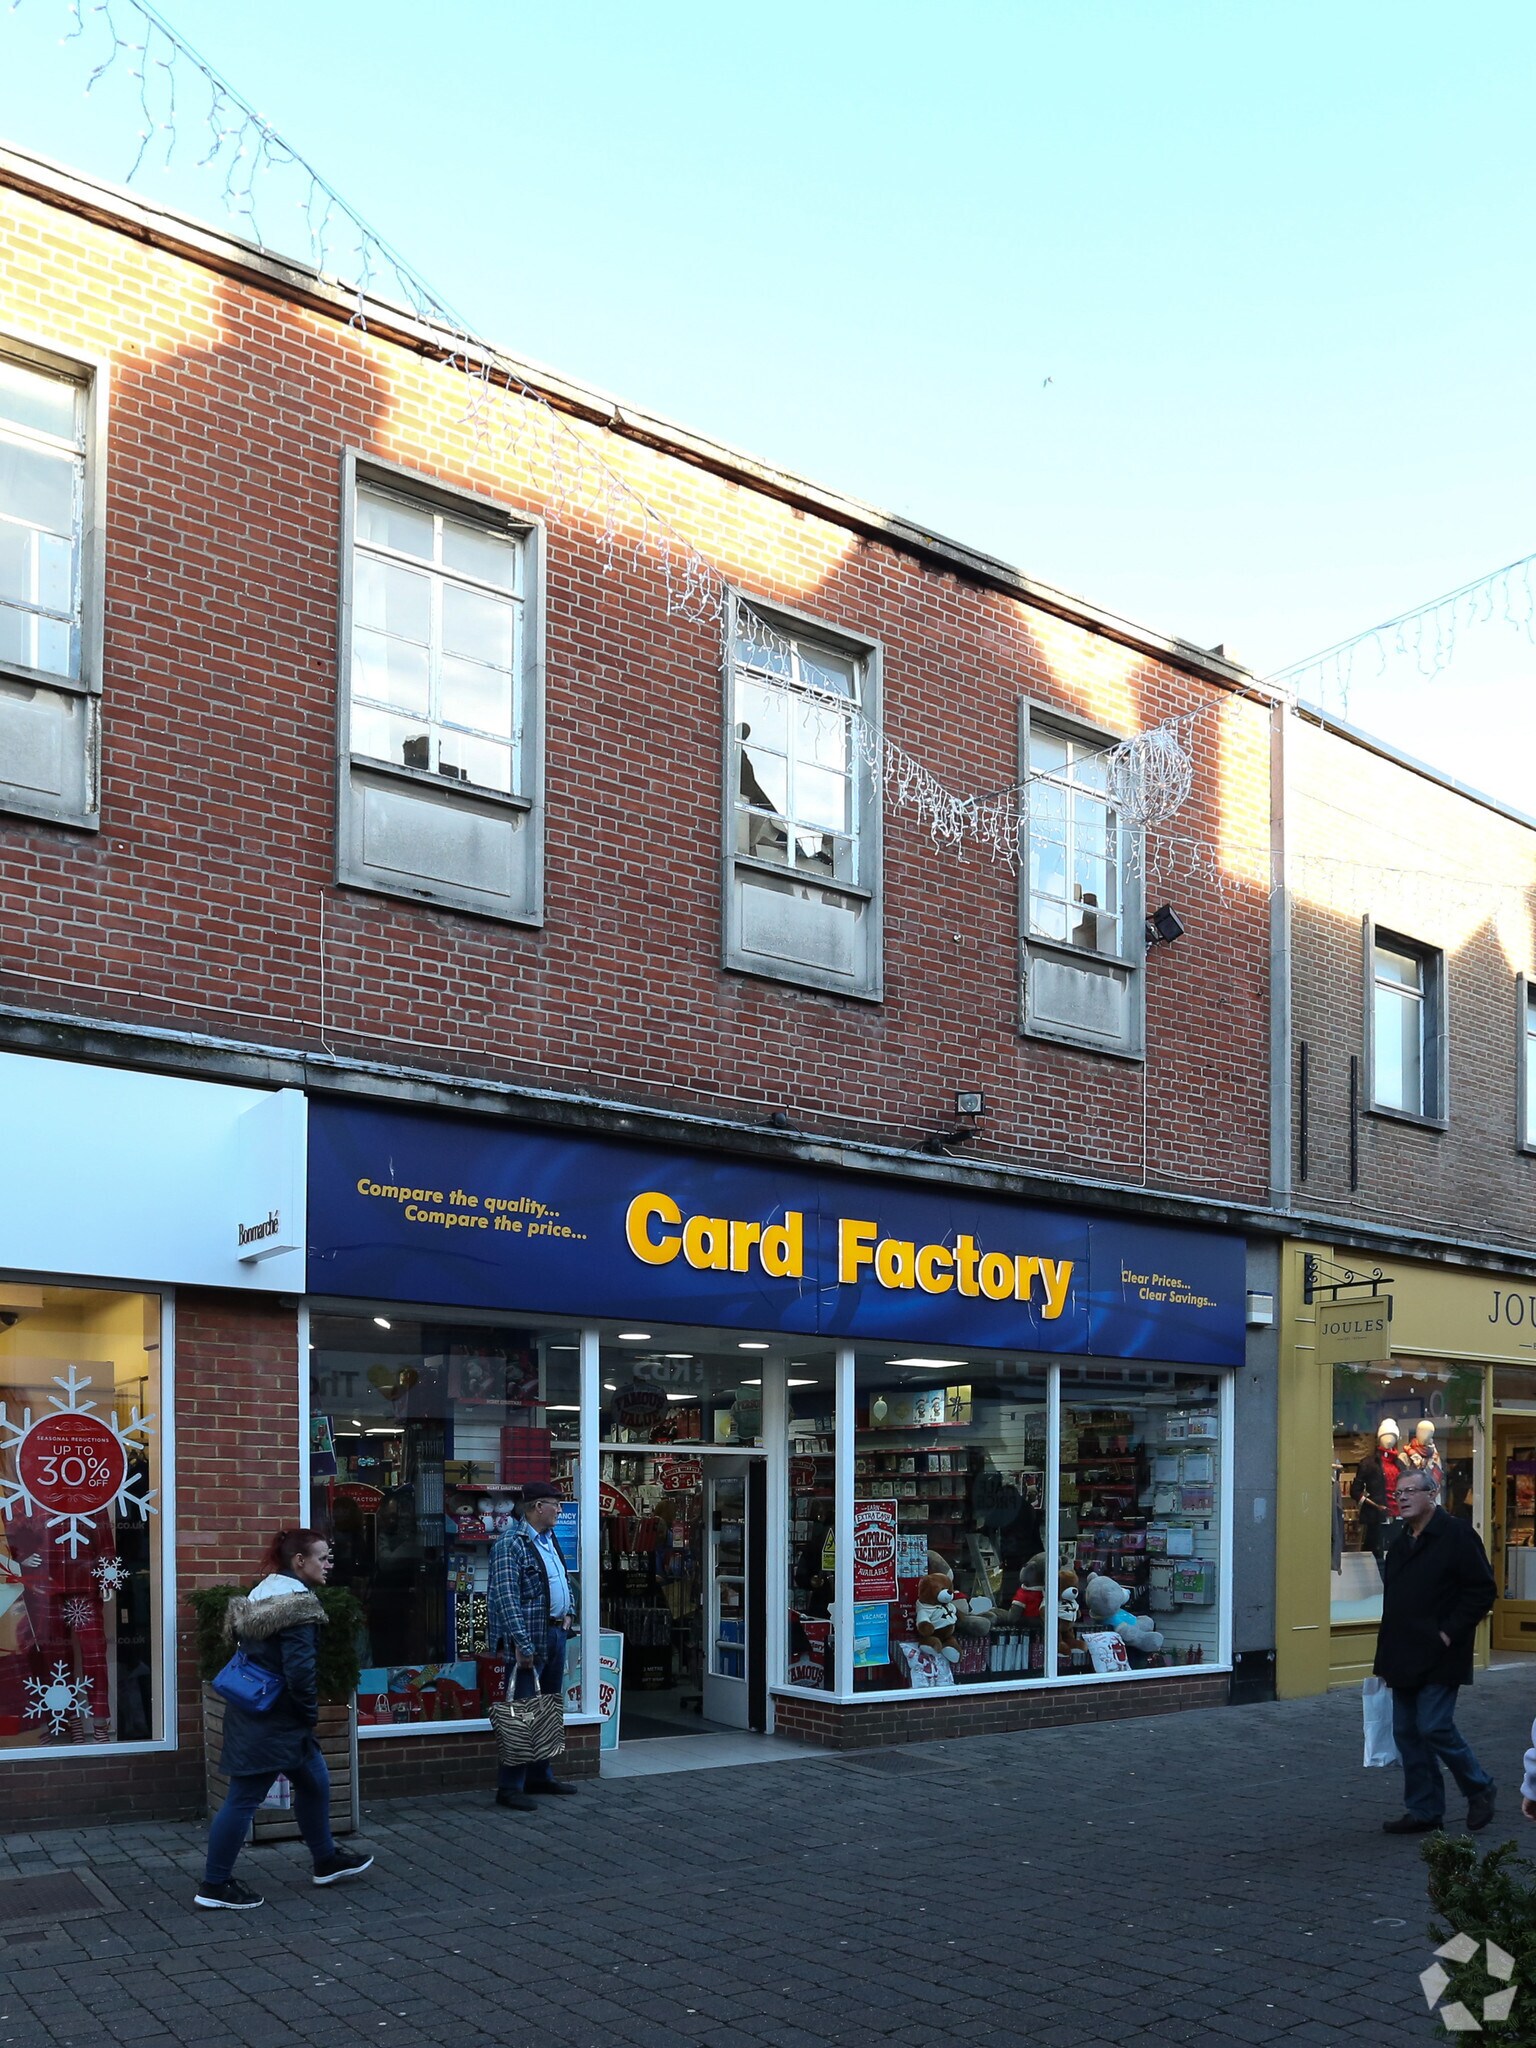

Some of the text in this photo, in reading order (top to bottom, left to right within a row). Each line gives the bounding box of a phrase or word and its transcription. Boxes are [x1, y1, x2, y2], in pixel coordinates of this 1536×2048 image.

[357, 1178, 560, 1218] Compare the quality...
[238, 1209, 279, 1246] Bonmarché
[404, 1205, 587, 1239] Compare the price...
[625, 1190, 1074, 1320] Card Factory
[1121, 1270, 1191, 1289] Clear Prices...
[1139, 1287, 1217, 1308] Clear Savings...
[1322, 1319, 1384, 1336] JOULES
[53, 1445, 94, 1456] UP TO
[36, 1456, 110, 1487] 30%
[88, 1479, 109, 1487] OFF
[671, 1476, 680, 1488] 3
[557, 1512, 577, 1520] ANCY
[857, 1512, 891, 1522] EXTRA CASH
[858, 1566, 889, 1577] AVAILABLE
[902, 1609, 908, 1618] 3
[600, 1657, 615, 1668] tory
